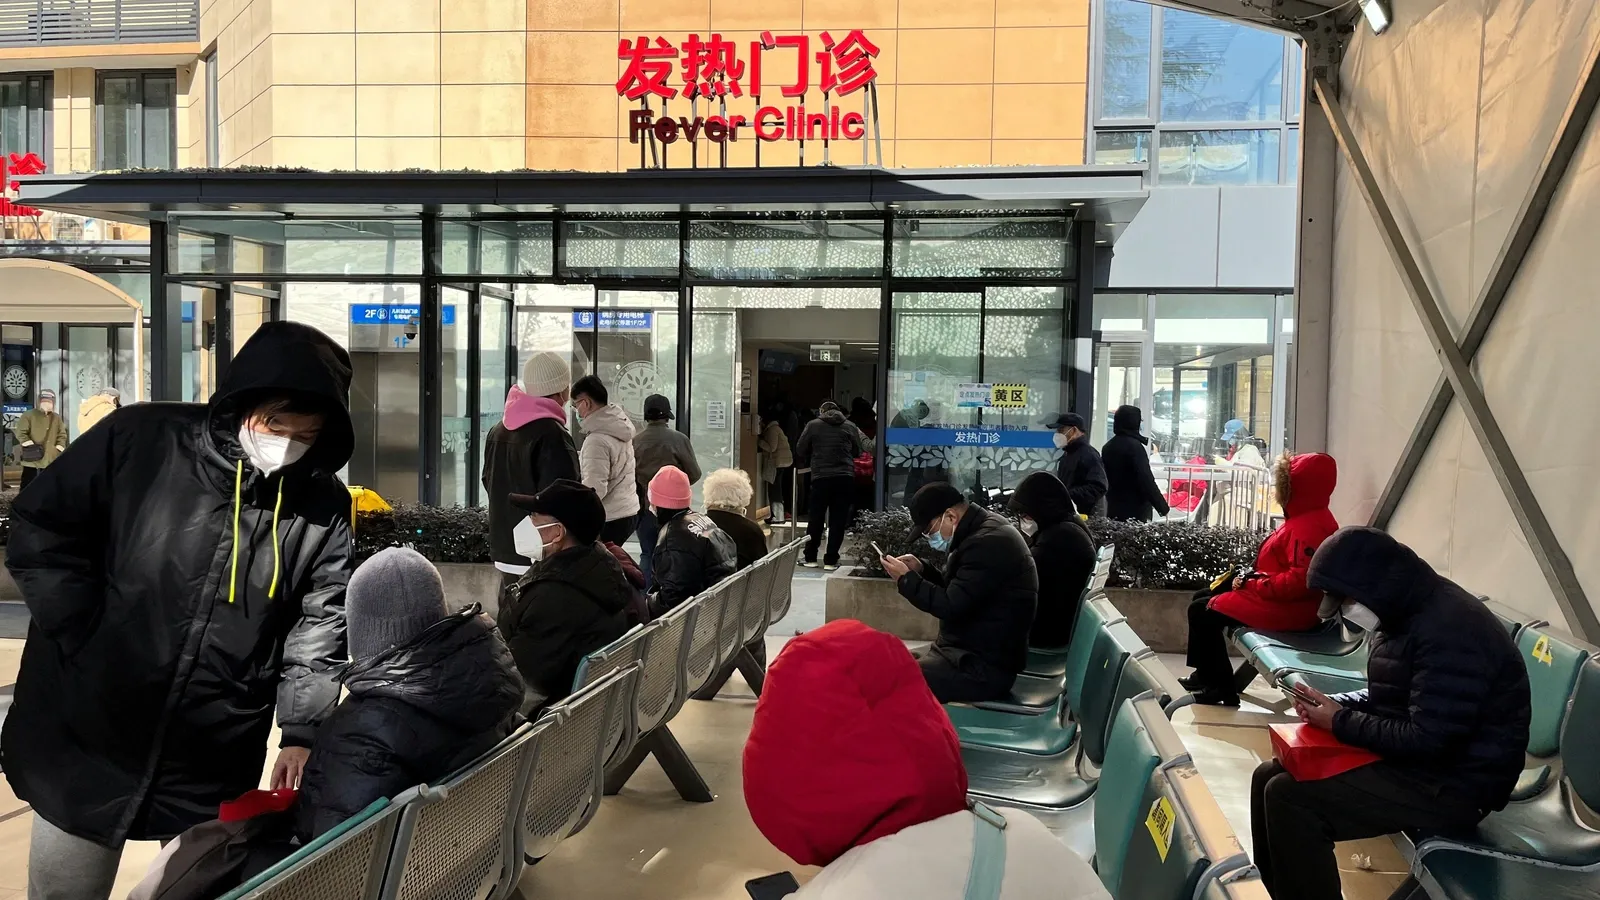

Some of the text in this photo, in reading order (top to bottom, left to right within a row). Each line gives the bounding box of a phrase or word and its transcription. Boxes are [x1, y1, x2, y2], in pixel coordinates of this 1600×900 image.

[615, 29, 880, 101] 发热门诊
[629, 105, 866, 144] Fever Clinic
[365, 309, 376, 318] 2F
[994, 389, 1024, 402] 黄区
[955, 432, 1001, 444] 发热门诊
